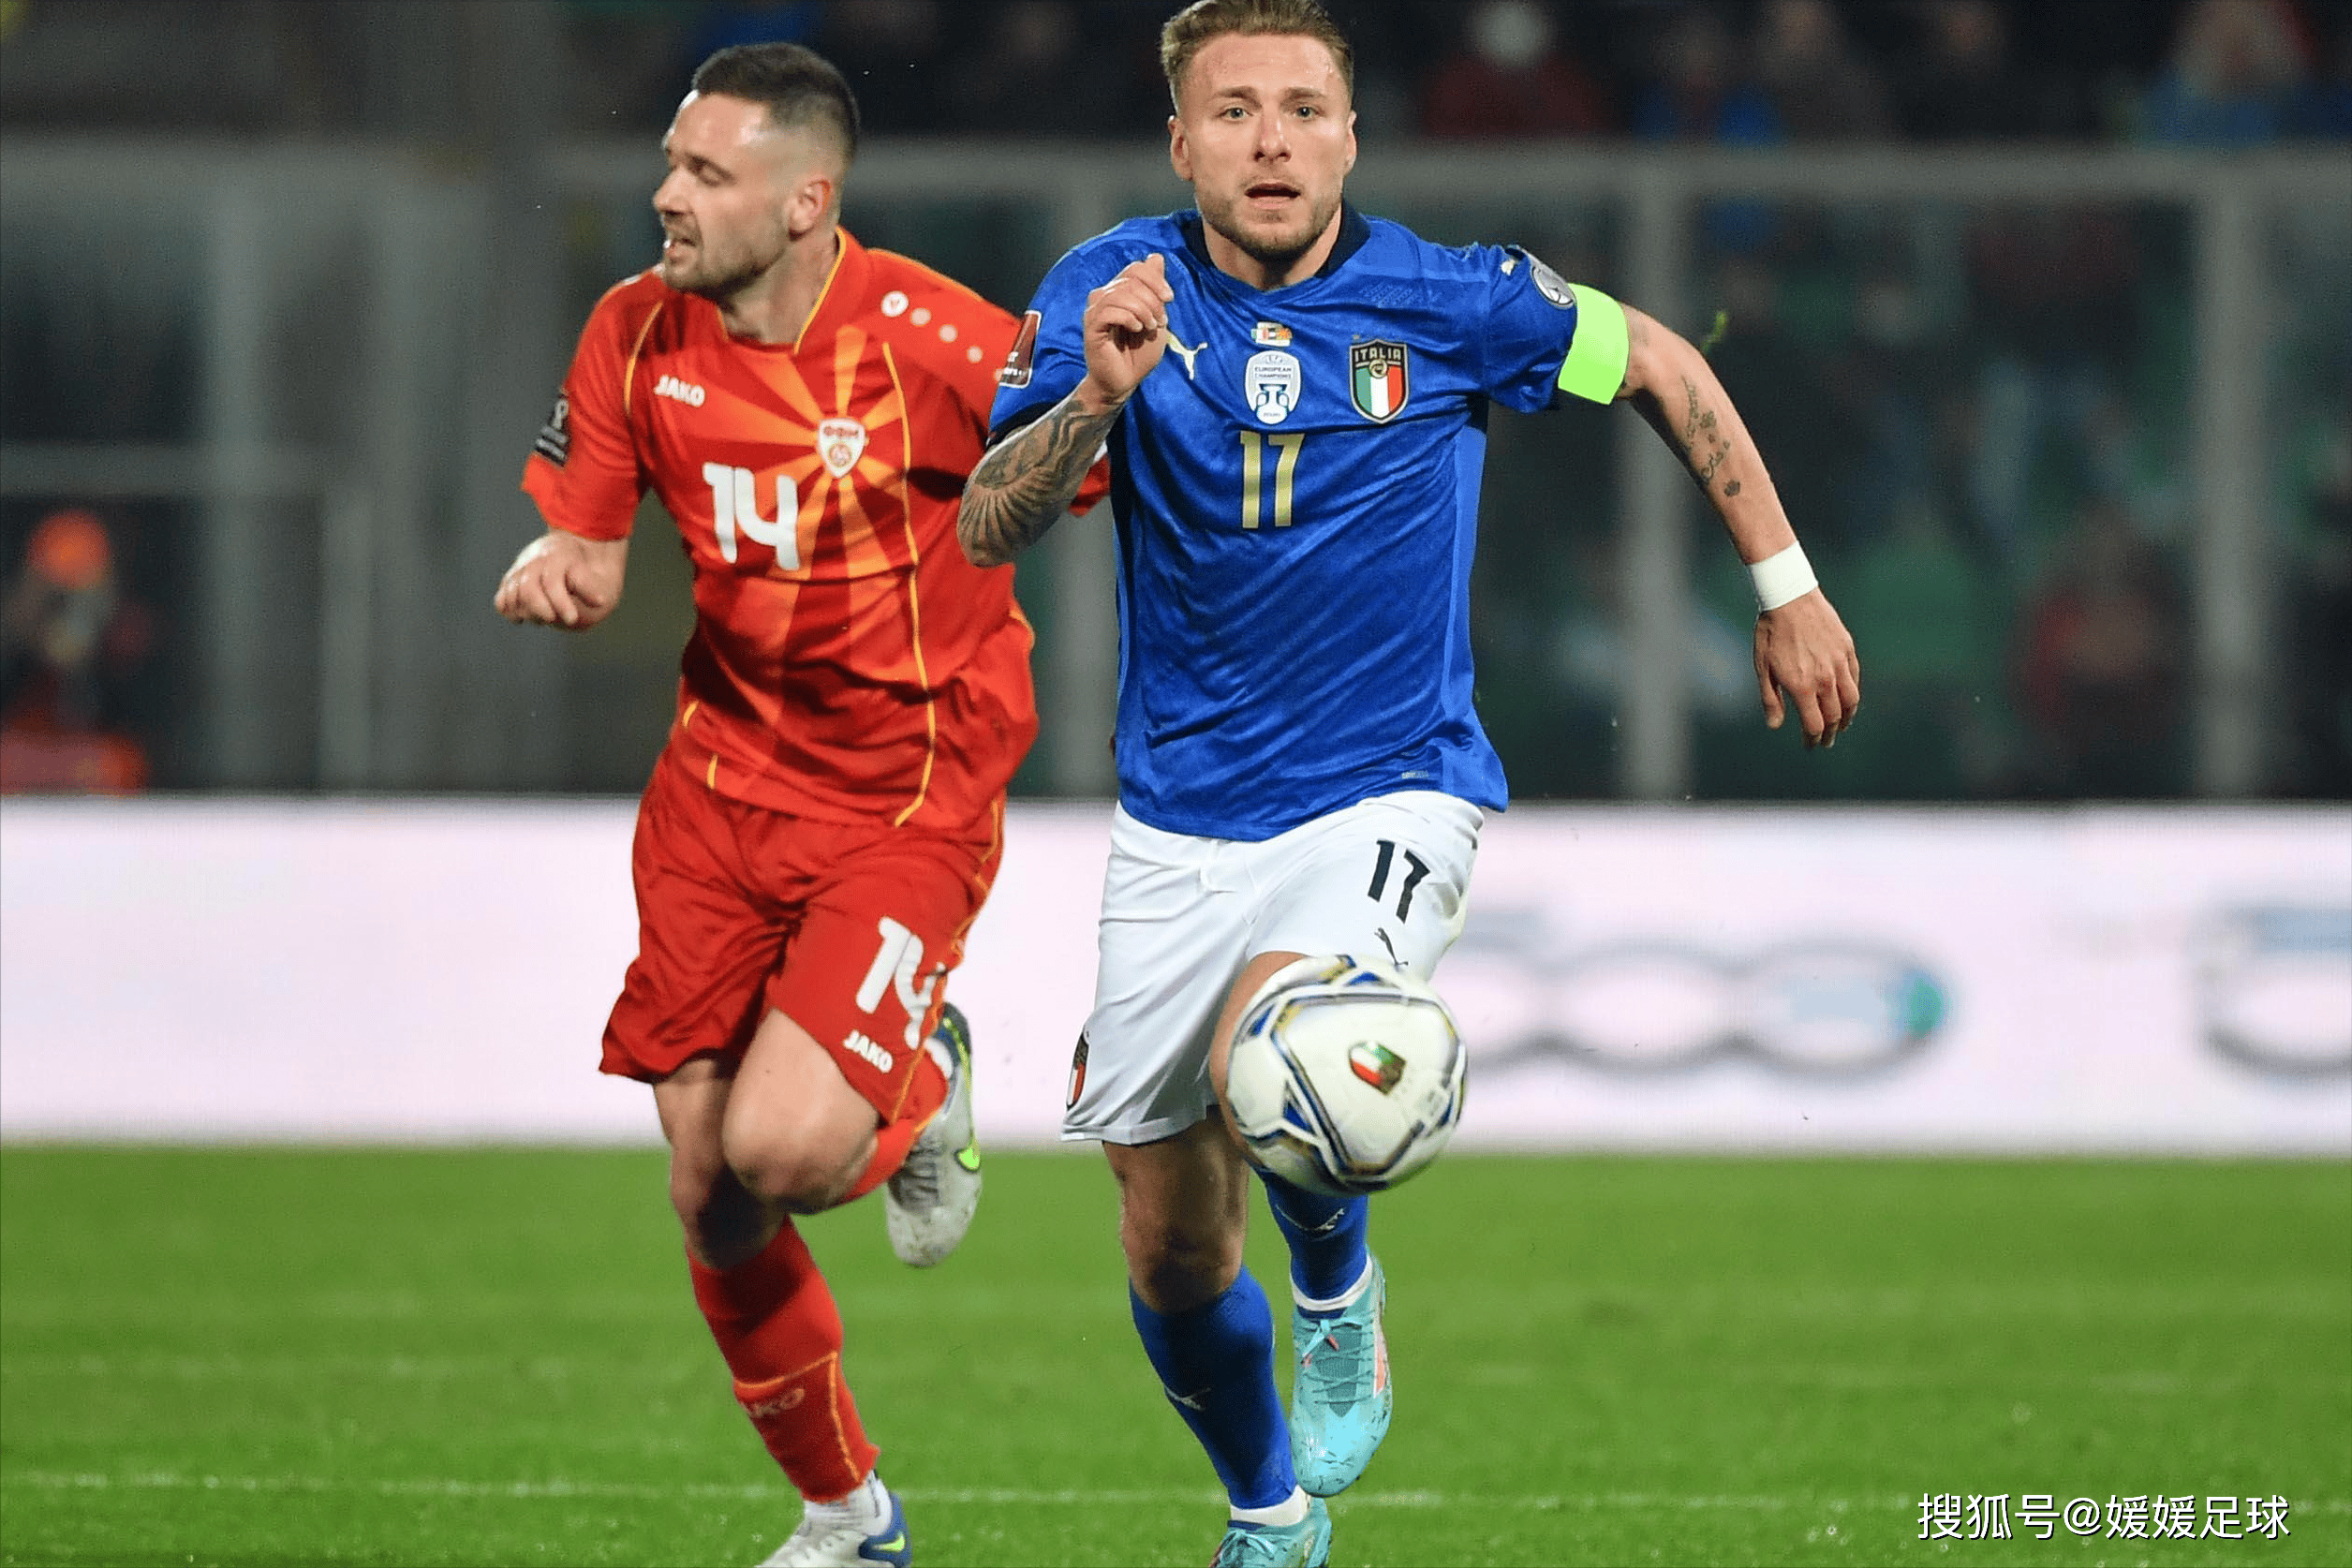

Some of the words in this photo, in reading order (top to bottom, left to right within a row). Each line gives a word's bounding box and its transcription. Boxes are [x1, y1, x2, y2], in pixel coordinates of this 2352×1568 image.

[654, 374, 706, 407] JAKO
[1354, 348, 1402, 362] ITALIA
[703, 463, 800, 570] 14
[1239, 430, 1305, 528] 17
[1368, 839, 1430, 924] 17
[856, 915, 949, 1050] 14
[844, 1029, 893, 1073] JAKO
